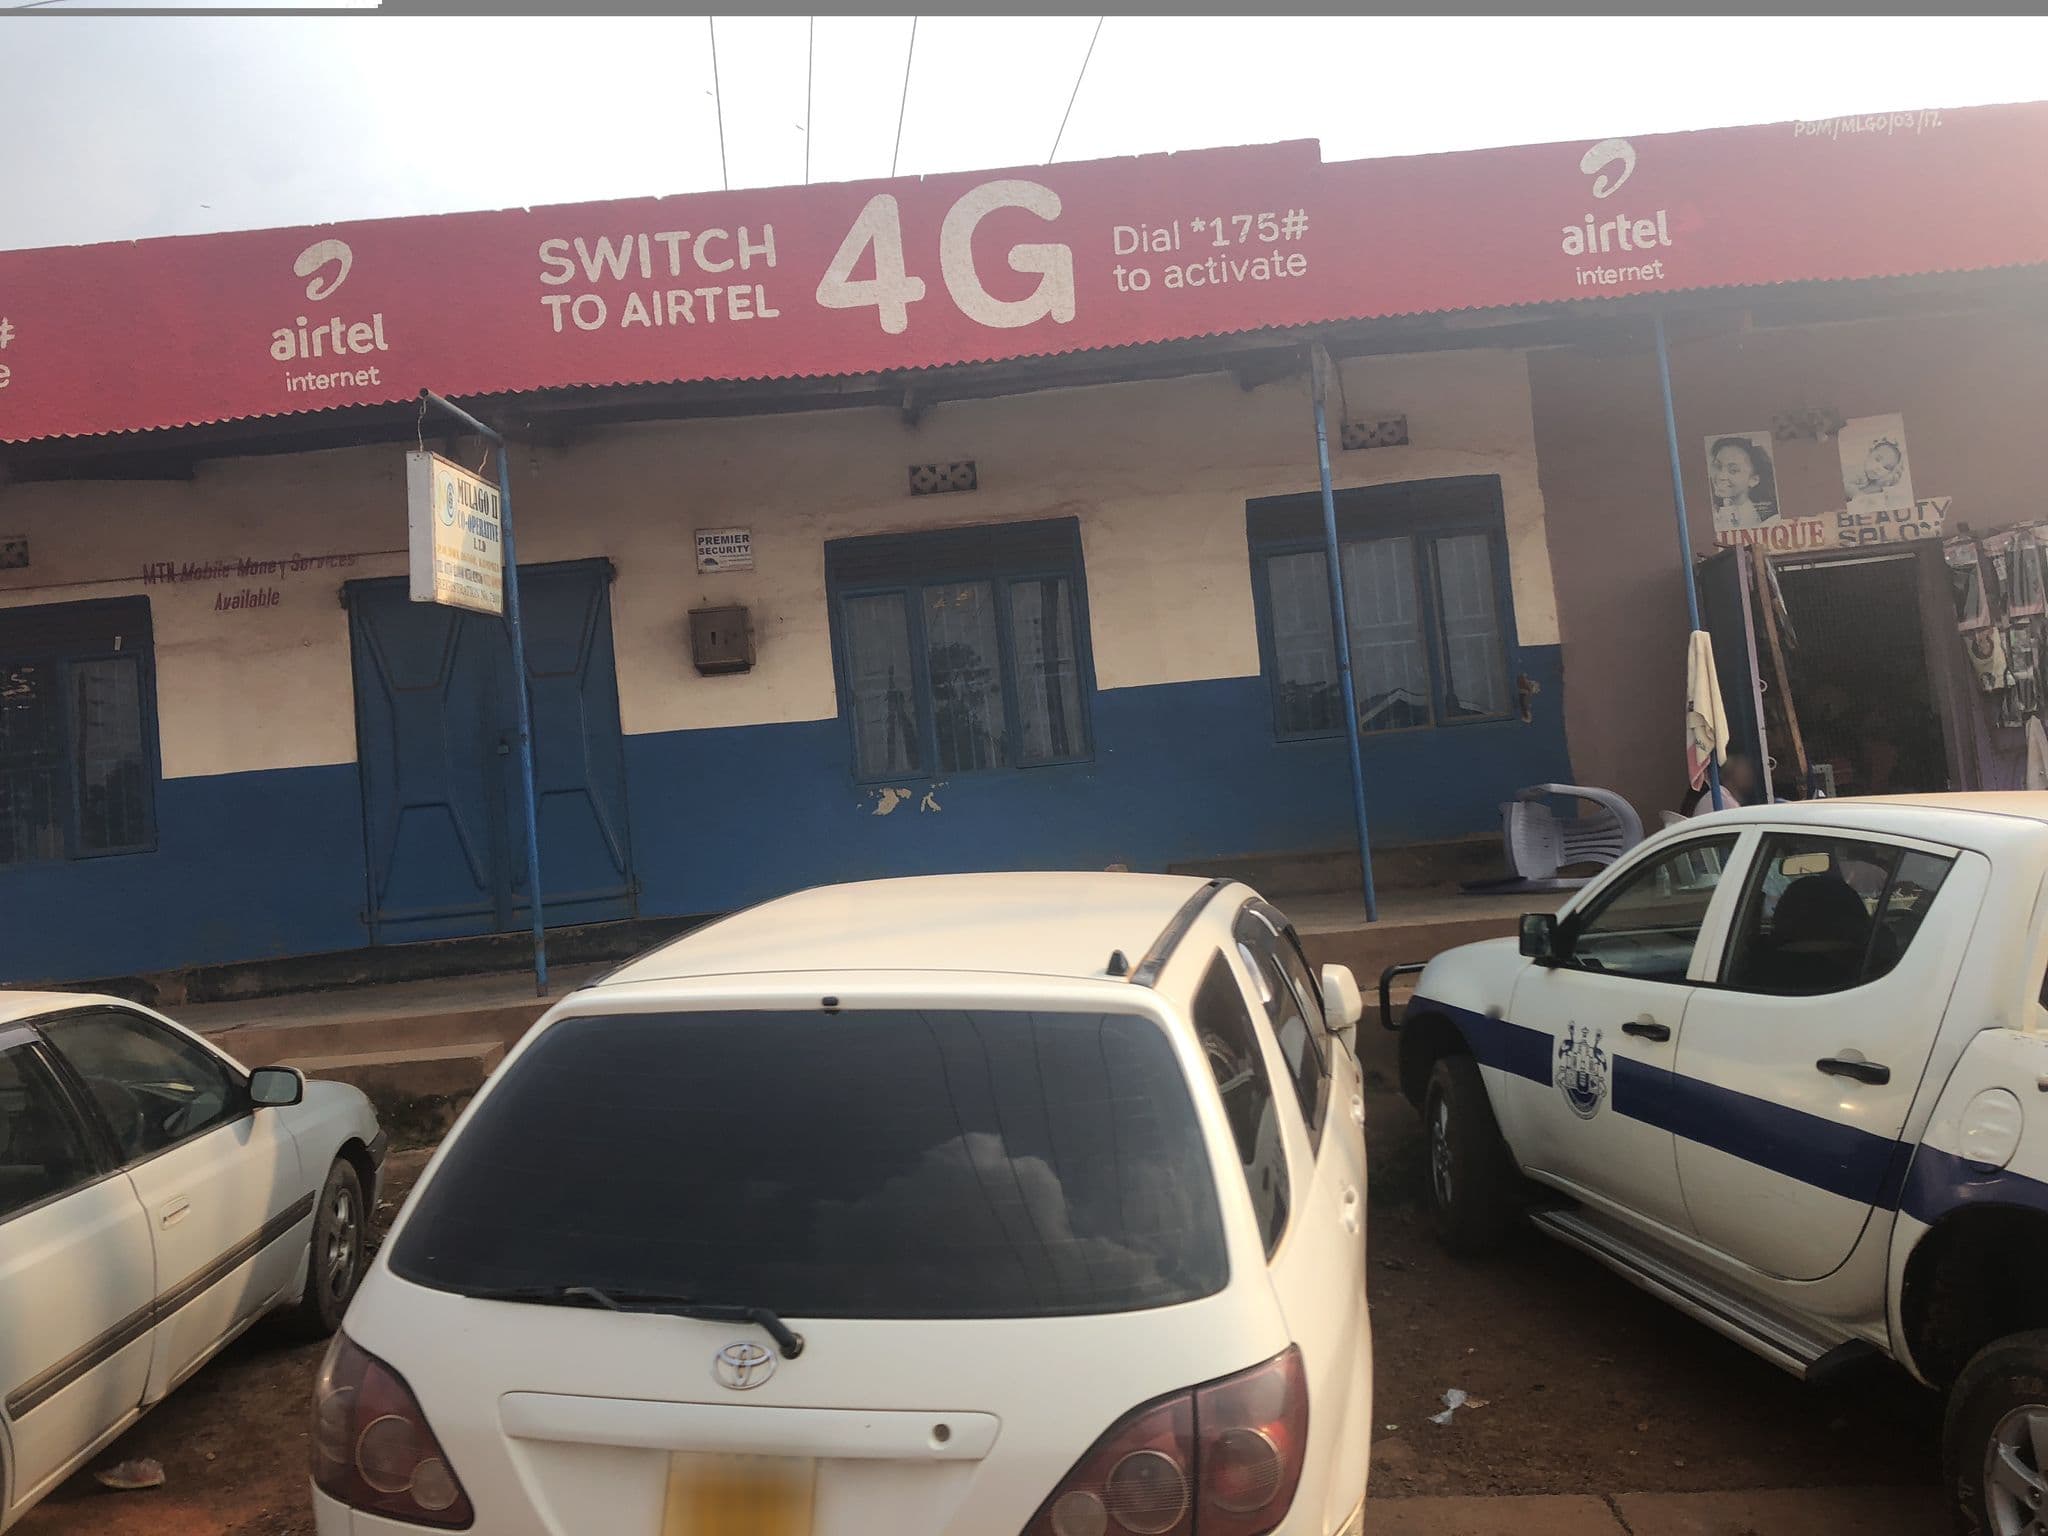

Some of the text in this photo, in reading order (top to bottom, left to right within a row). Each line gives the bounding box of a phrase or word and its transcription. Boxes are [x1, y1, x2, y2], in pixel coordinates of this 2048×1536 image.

[1113, 218, 1181, 255] Dial
[1562, 209, 1672, 256] airtel
[540, 179, 1076, 335] SWITCH 4G
[1113, 249, 1308, 292] to activate
[1575, 259, 1664, 285] internet
[541, 284, 781, 332] TO AIRTEL
[270, 312, 389, 361] airtel
[285, 366, 381, 392] internet
[457, 478, 489, 516] MULAGO
[457, 509, 498, 543] CO-OPERATIVE
[1837, 500, 1951, 528] BEAUTY
[698, 534, 750, 546] PREMIER
[698, 545, 750, 556] SECURITY
[1720, 520, 1825, 550] UNIQUE
[143, 552, 356, 585] MTN Mobile Money Services
[214, 586, 281, 612] Available
